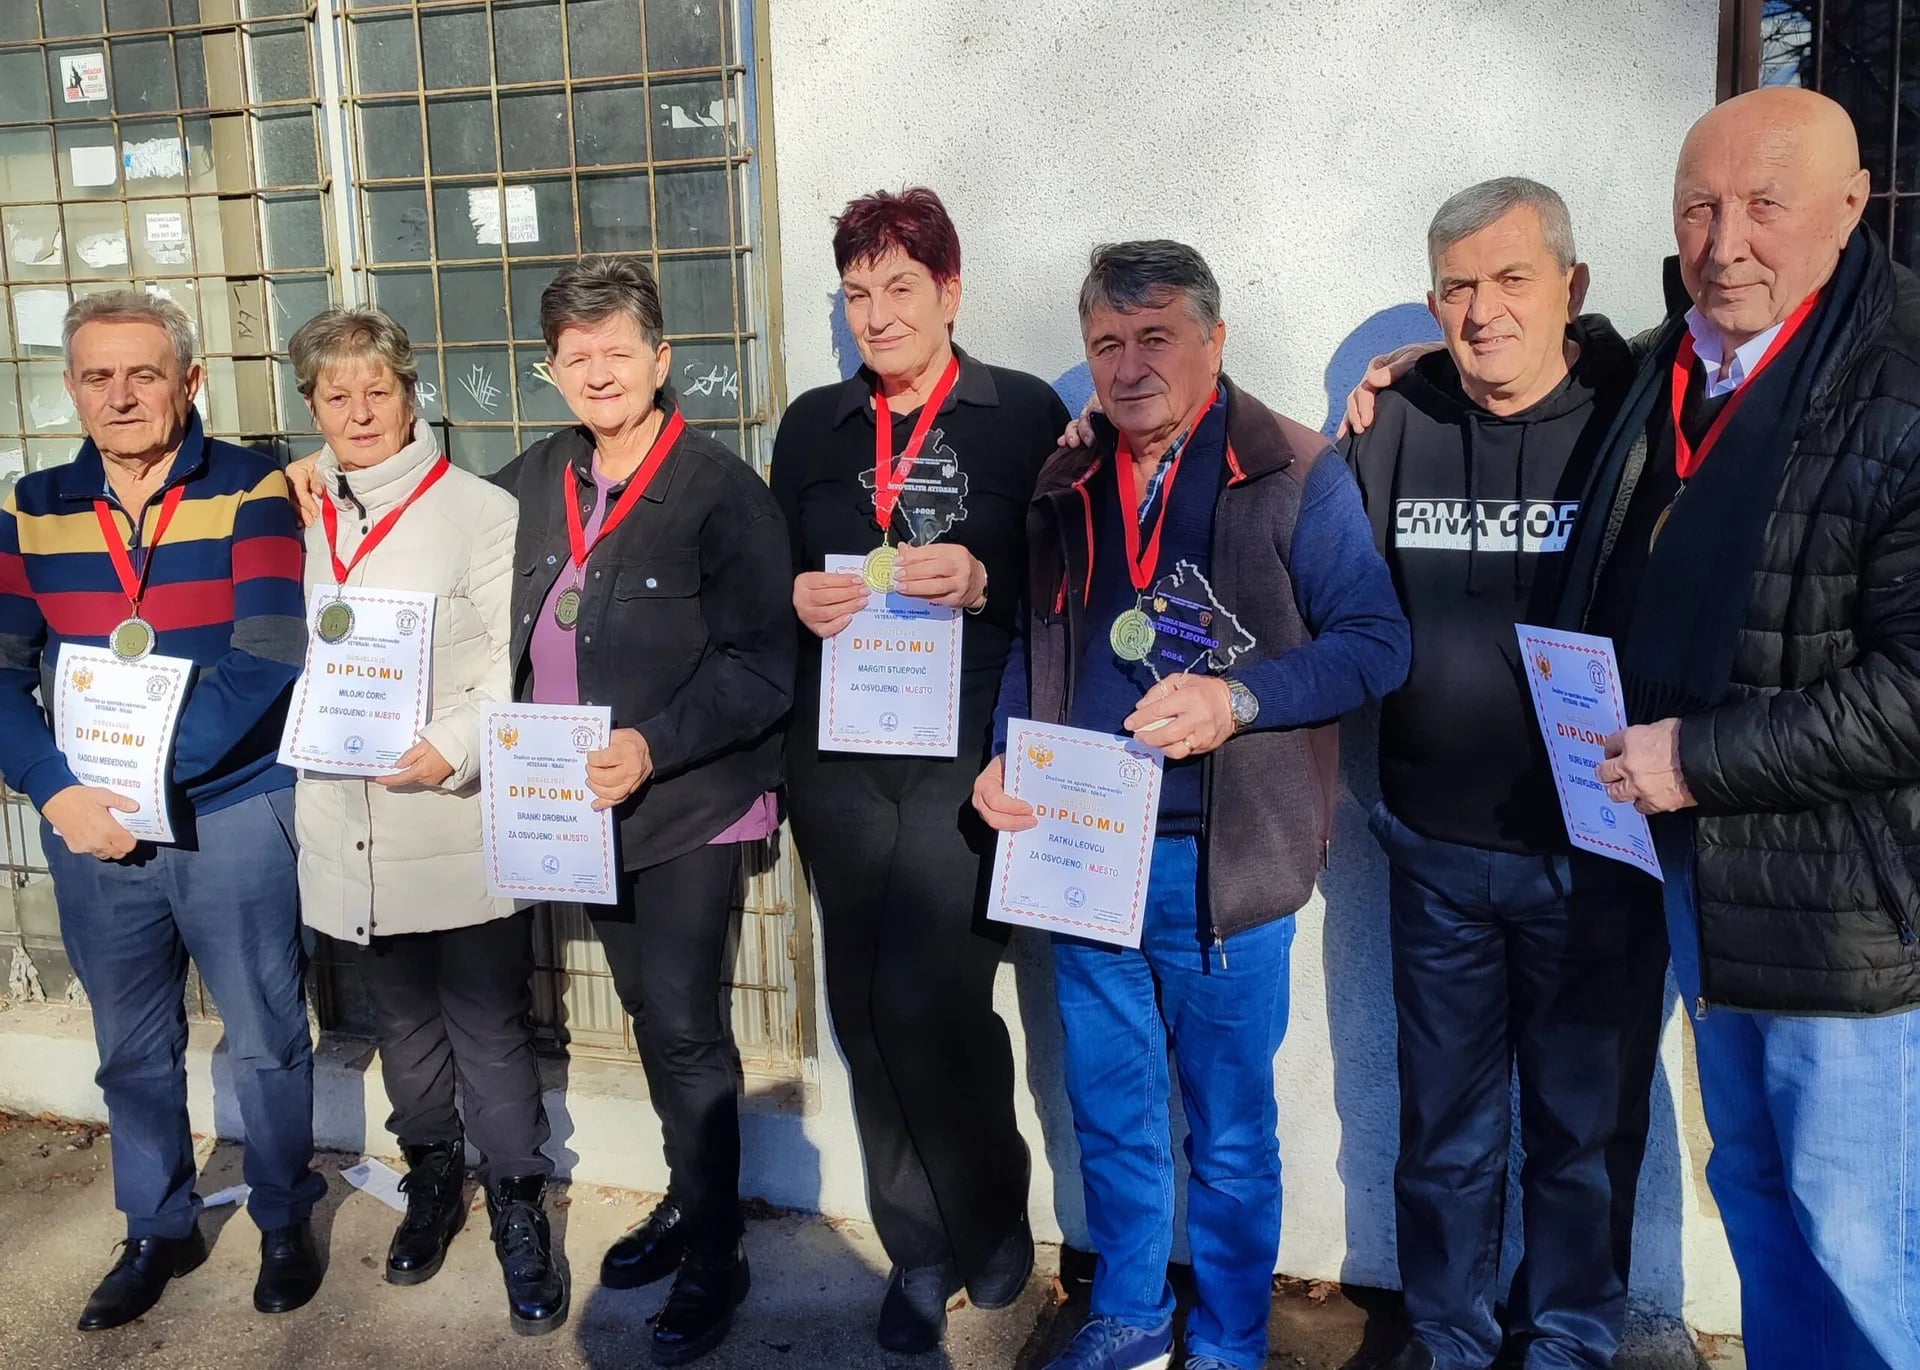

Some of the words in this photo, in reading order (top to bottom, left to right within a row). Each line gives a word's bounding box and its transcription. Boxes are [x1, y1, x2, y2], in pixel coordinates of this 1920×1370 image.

[1396, 501, 1489, 537] CRNA
[853, 638, 934, 652] DIPLOMU
[326, 662, 403, 680] DIPLOMU
[858, 664, 886, 673] MARGITI
[887, 666, 926, 675] STIJEPOVIĆ
[339, 689, 364, 699] MILOJKI
[850, 683, 859, 691] ZA
[905, 686, 933, 694] MJESTO
[319, 706, 328, 714] ZA
[330, 706, 368, 718] OSVOJENO:
[374, 711, 400, 721] MJESTO
[76, 726, 145, 747] DIPLOMU
[1557, 722, 1606, 747] DIPLOM
[77, 753, 98, 764] RADOJU
[117, 778, 141, 788] MJESTO
[509, 786, 584, 801] DIPLOMU
[517, 812, 541, 821] BRANKI
[542, 814, 578, 823] DROBNJAK
[1036, 804, 1125, 834] DIPLOMU
[508, 831, 517, 839] ZA
[518, 831, 554, 840] OSVOJENO:
[563, 833, 588, 842] MJESTO
[1049, 834, 1074, 846] RATKU
[1075, 840, 1104, 853] LEOVCU
[1030, 850, 1039, 860] ZA
[1089, 863, 1118, 877] MJESTO
